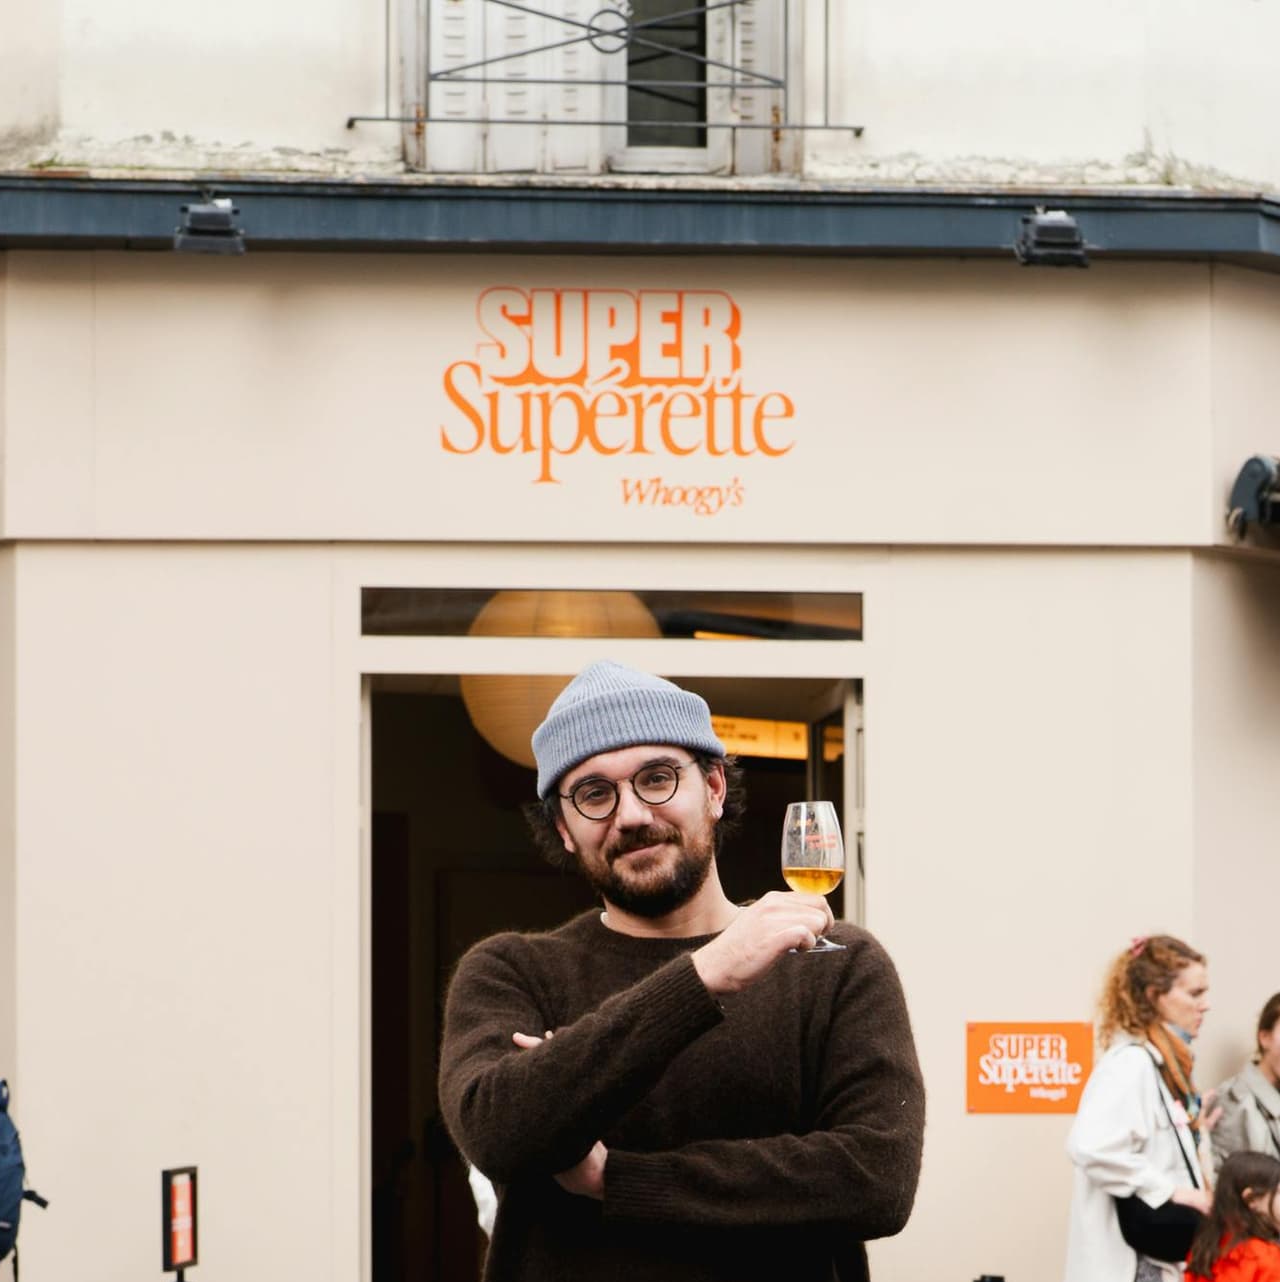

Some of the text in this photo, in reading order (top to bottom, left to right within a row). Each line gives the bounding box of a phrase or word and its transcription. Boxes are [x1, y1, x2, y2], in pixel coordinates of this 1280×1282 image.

[476, 286, 742, 387] SUPER
[440, 359, 796, 484] Supérette
[620, 477, 745, 516] Whoogy's
[989, 1033, 1067, 1063] SUPER
